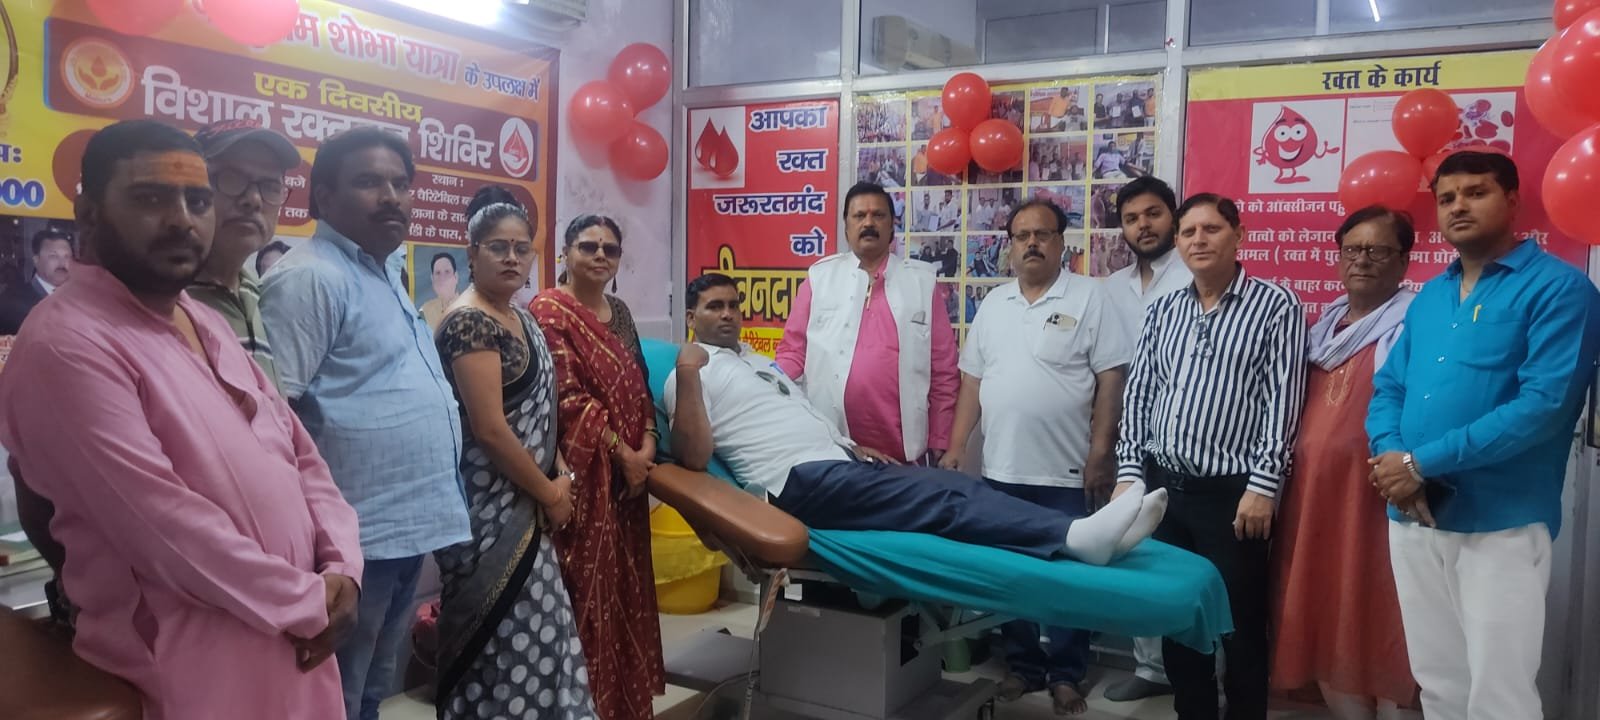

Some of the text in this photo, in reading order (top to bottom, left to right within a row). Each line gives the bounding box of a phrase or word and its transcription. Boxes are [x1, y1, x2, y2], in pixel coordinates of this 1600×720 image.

[327, 14, 397, 66] शोभा
[403, 38, 460, 82] यात्रा
[465, 63, 480, 86] के
[483, 71, 527, 97] उपलक्ष
[527, 77, 541, 101] में
[1322, 60, 1442, 90] रक्त के कार्य
[253, 72, 423, 123] एक दिवसीय
[140, 65, 274, 129] विशाल
[417, 118, 495, 169] शिविर
[750, 106, 828, 130] आपका
[776, 150, 827, 171] रक्त
[713, 186, 826, 214] जरूरतमंद
[1248, 201, 1263, 213] को
[285, 207, 309, 219] तक
[791, 228, 825, 255] को
[1278, 228, 1295, 242] को
[1283, 249, 1307, 261] रक्त
[1310, 247, 1321, 261] में
